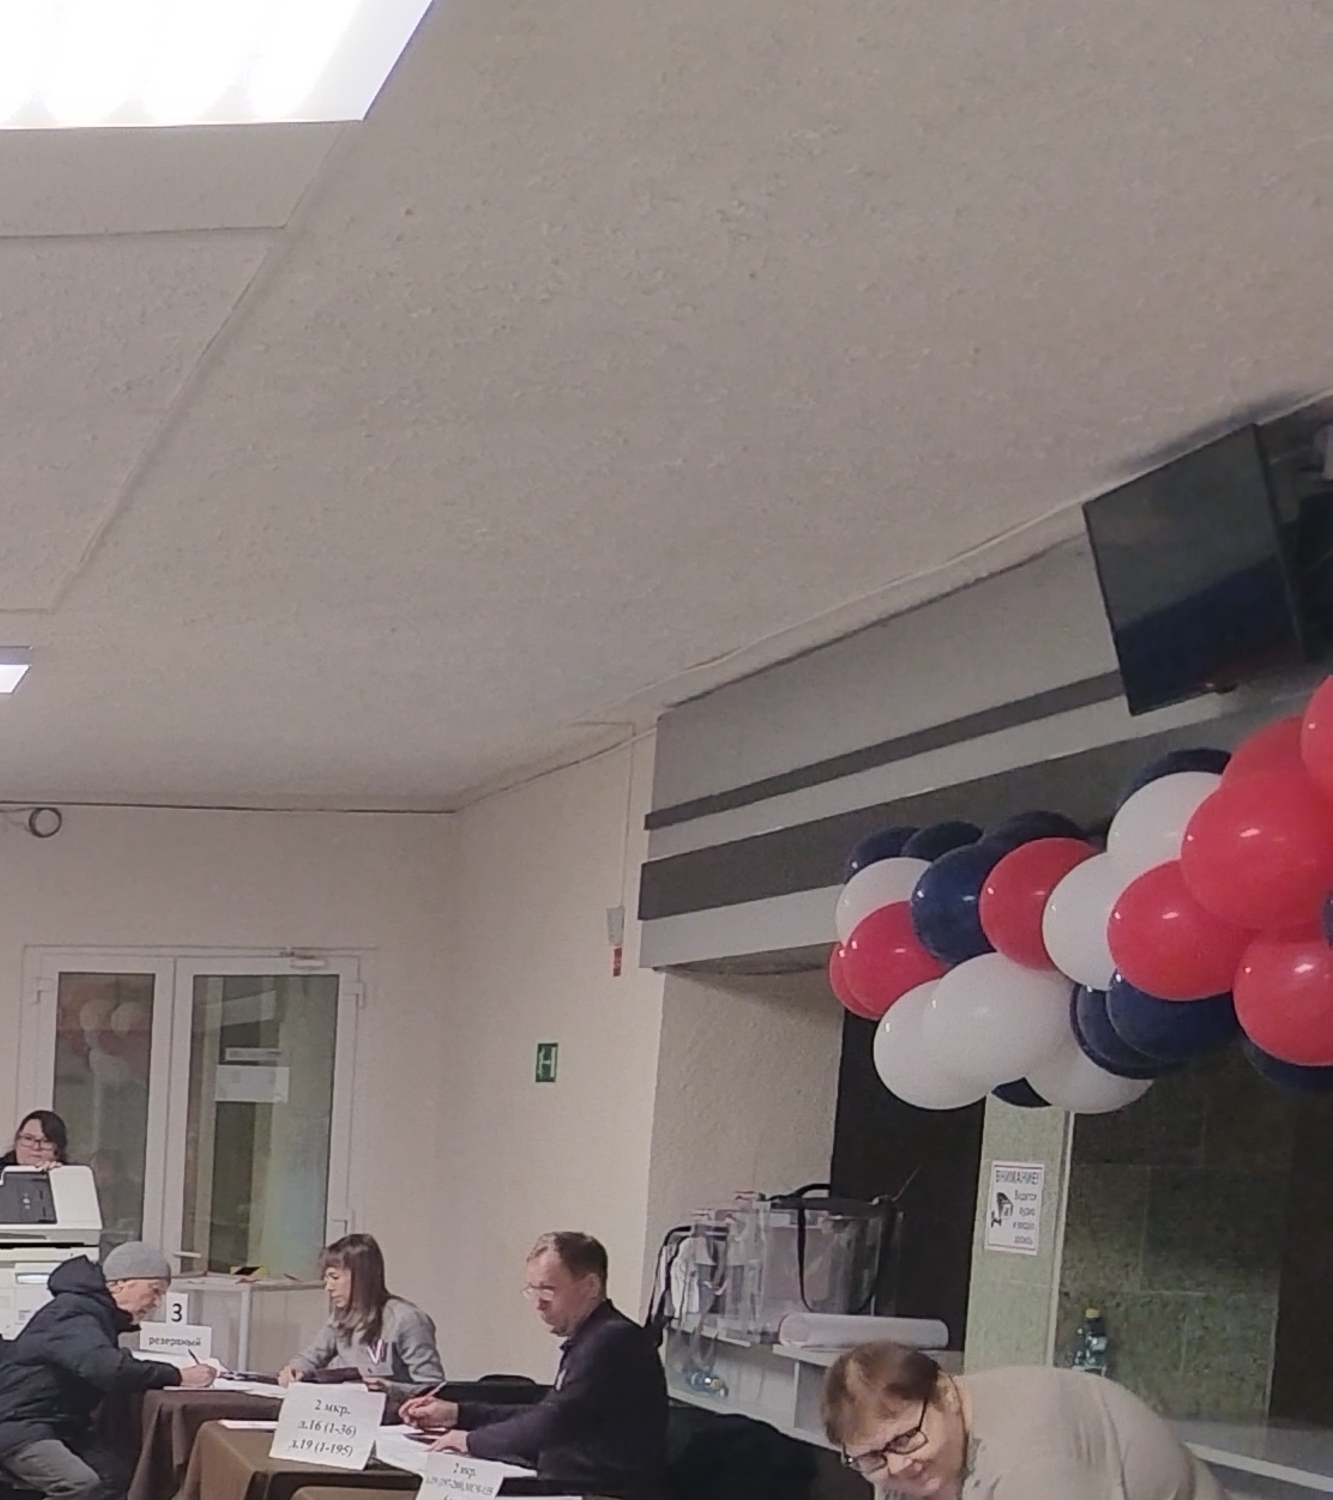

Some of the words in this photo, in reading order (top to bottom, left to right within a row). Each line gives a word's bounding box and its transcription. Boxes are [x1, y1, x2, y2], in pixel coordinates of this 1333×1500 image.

[171, 1303, 183, 1322] 3
[149, 1336, 202, 1347] резервный
[314, 1399, 322, 1411] 2
[324, 1403, 351, 1417] мкр.
[297, 1419, 322, 1431] д.16
[324, 1422, 357, 1439] (1-36)
[289, 1438, 313, 1450] д.19
[314, 1441, 354, 1458] (1-195)
